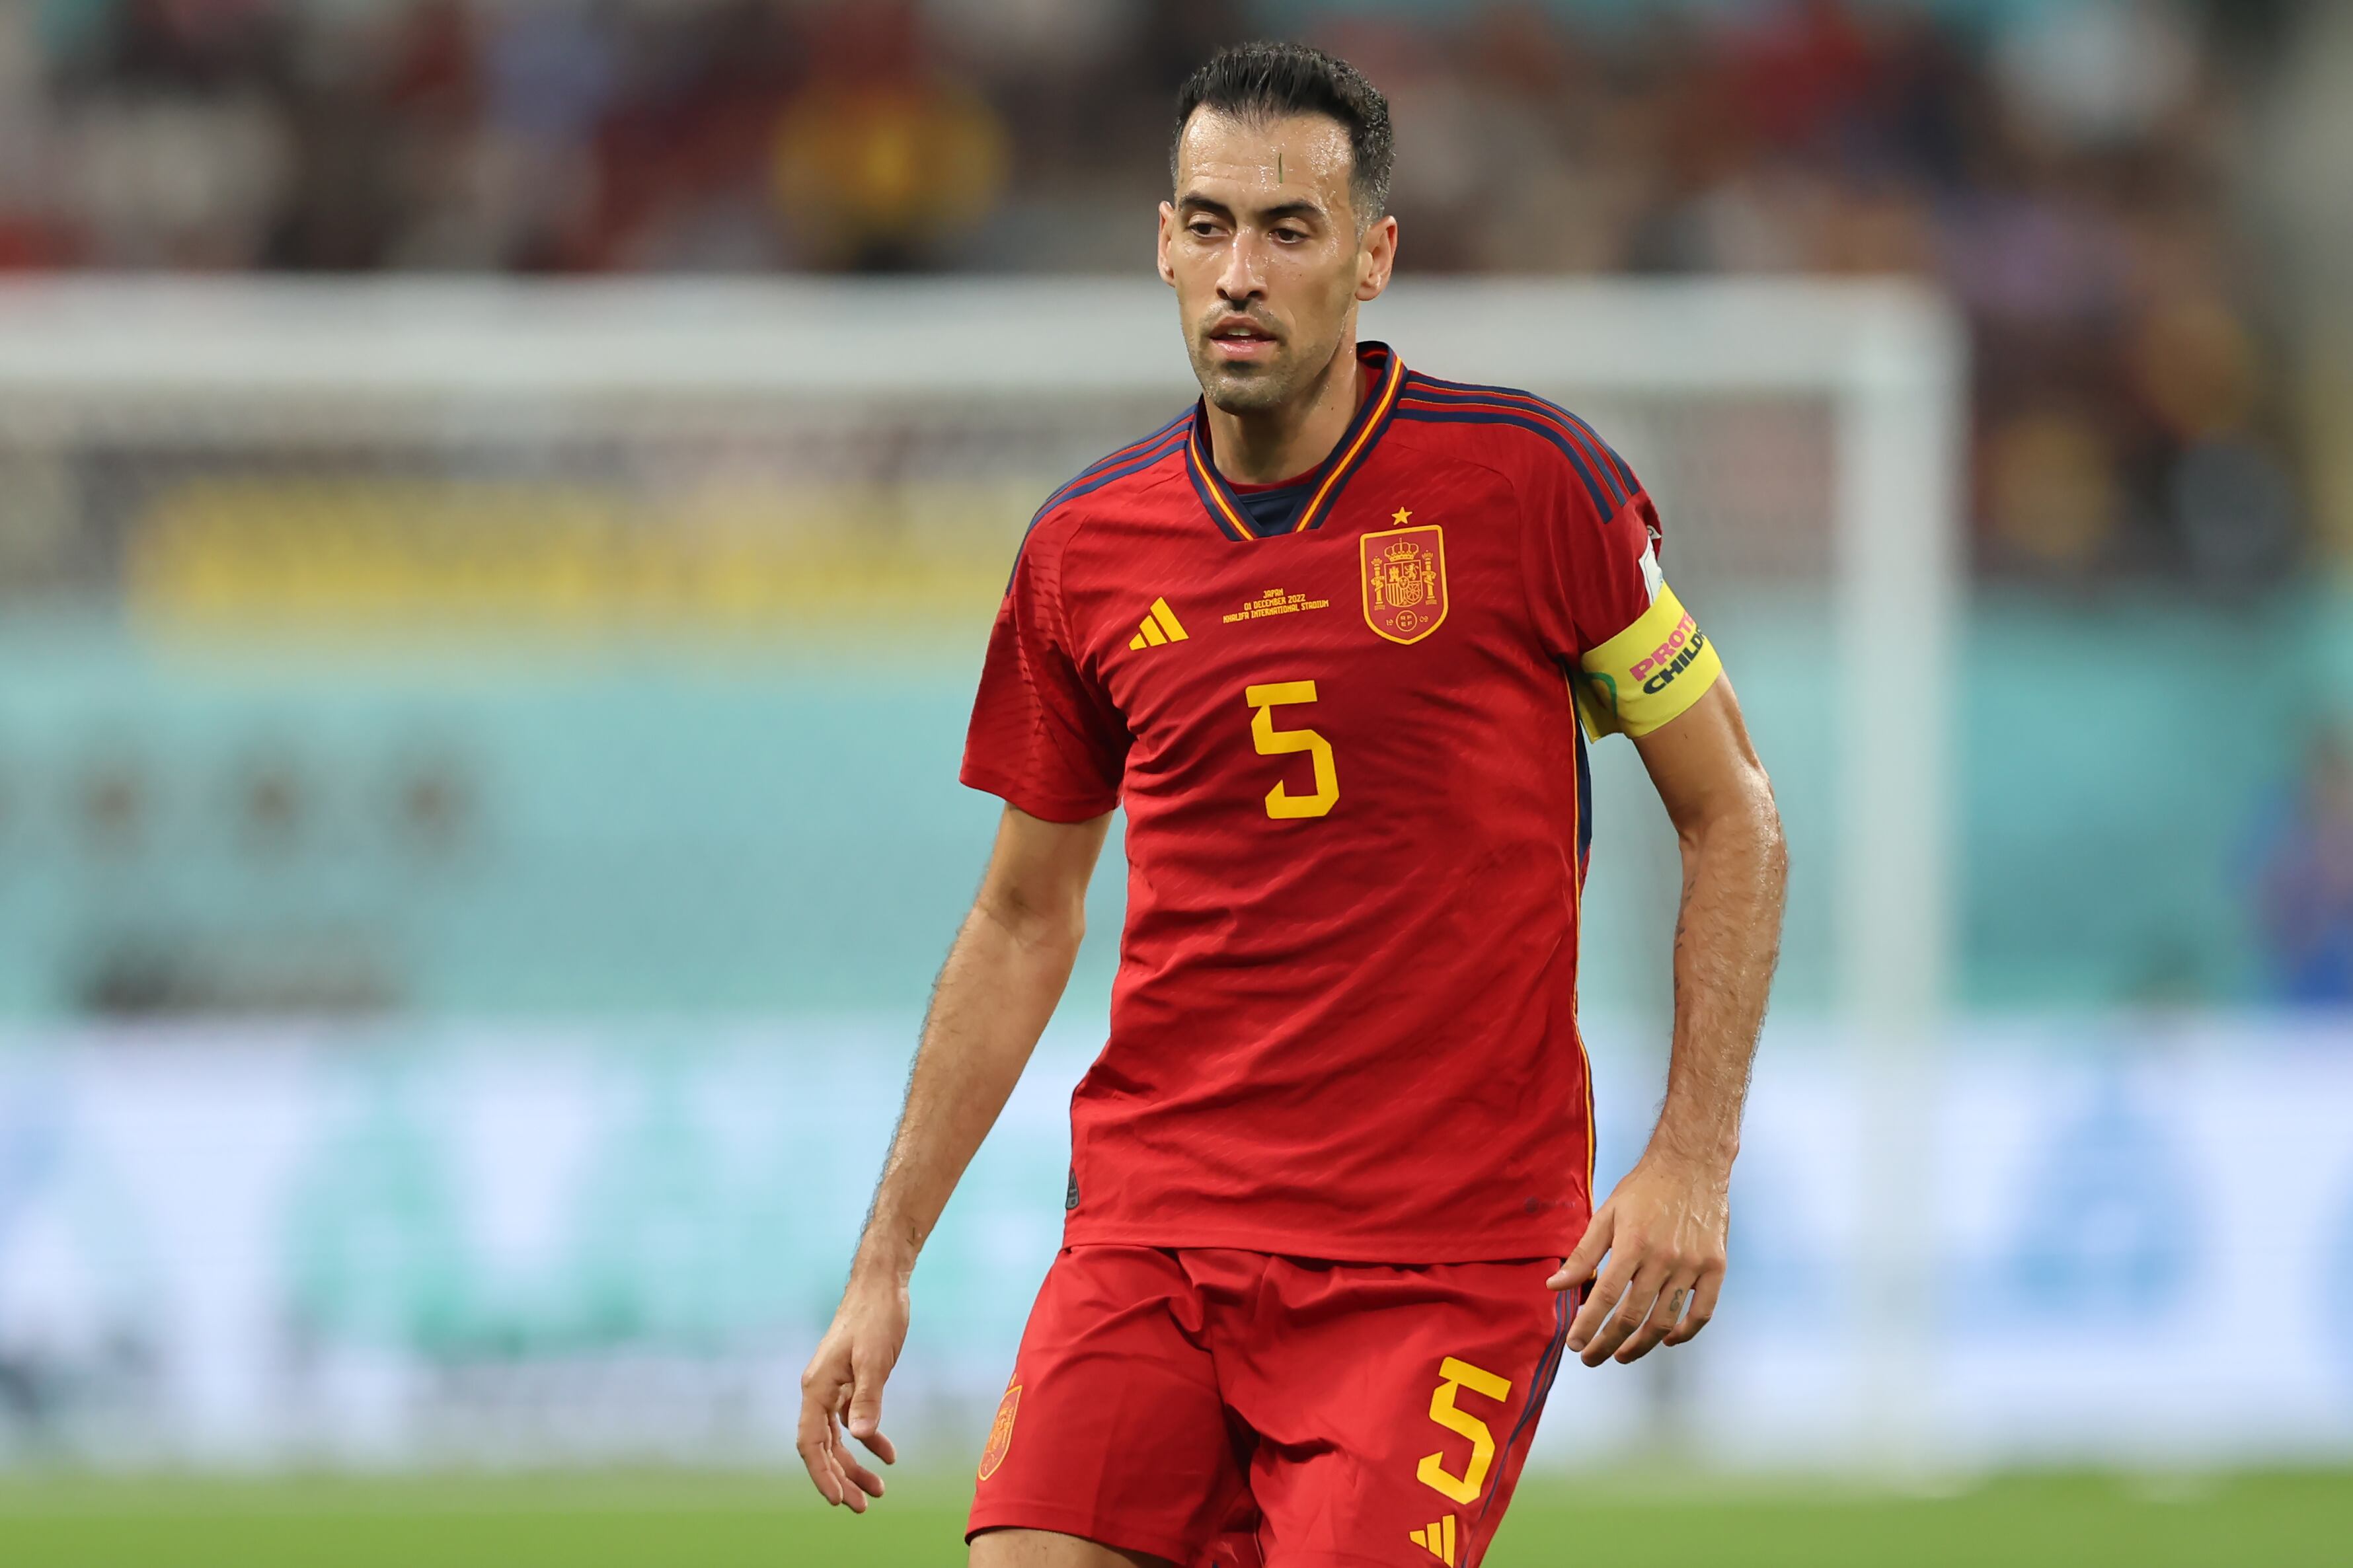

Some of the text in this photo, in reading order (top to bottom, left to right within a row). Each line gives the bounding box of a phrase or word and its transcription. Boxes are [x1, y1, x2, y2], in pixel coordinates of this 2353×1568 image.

[1244, 593, 1306, 611] 01 DECEMBER 2022
[1263, 587, 1284, 599] JAPAN
[1223, 599, 1329, 624] KHALIFA INTERNATIONAL STADIUM
[1245, 679, 1340, 819] 5
[1416, 1356, 1512, 1505] 5
